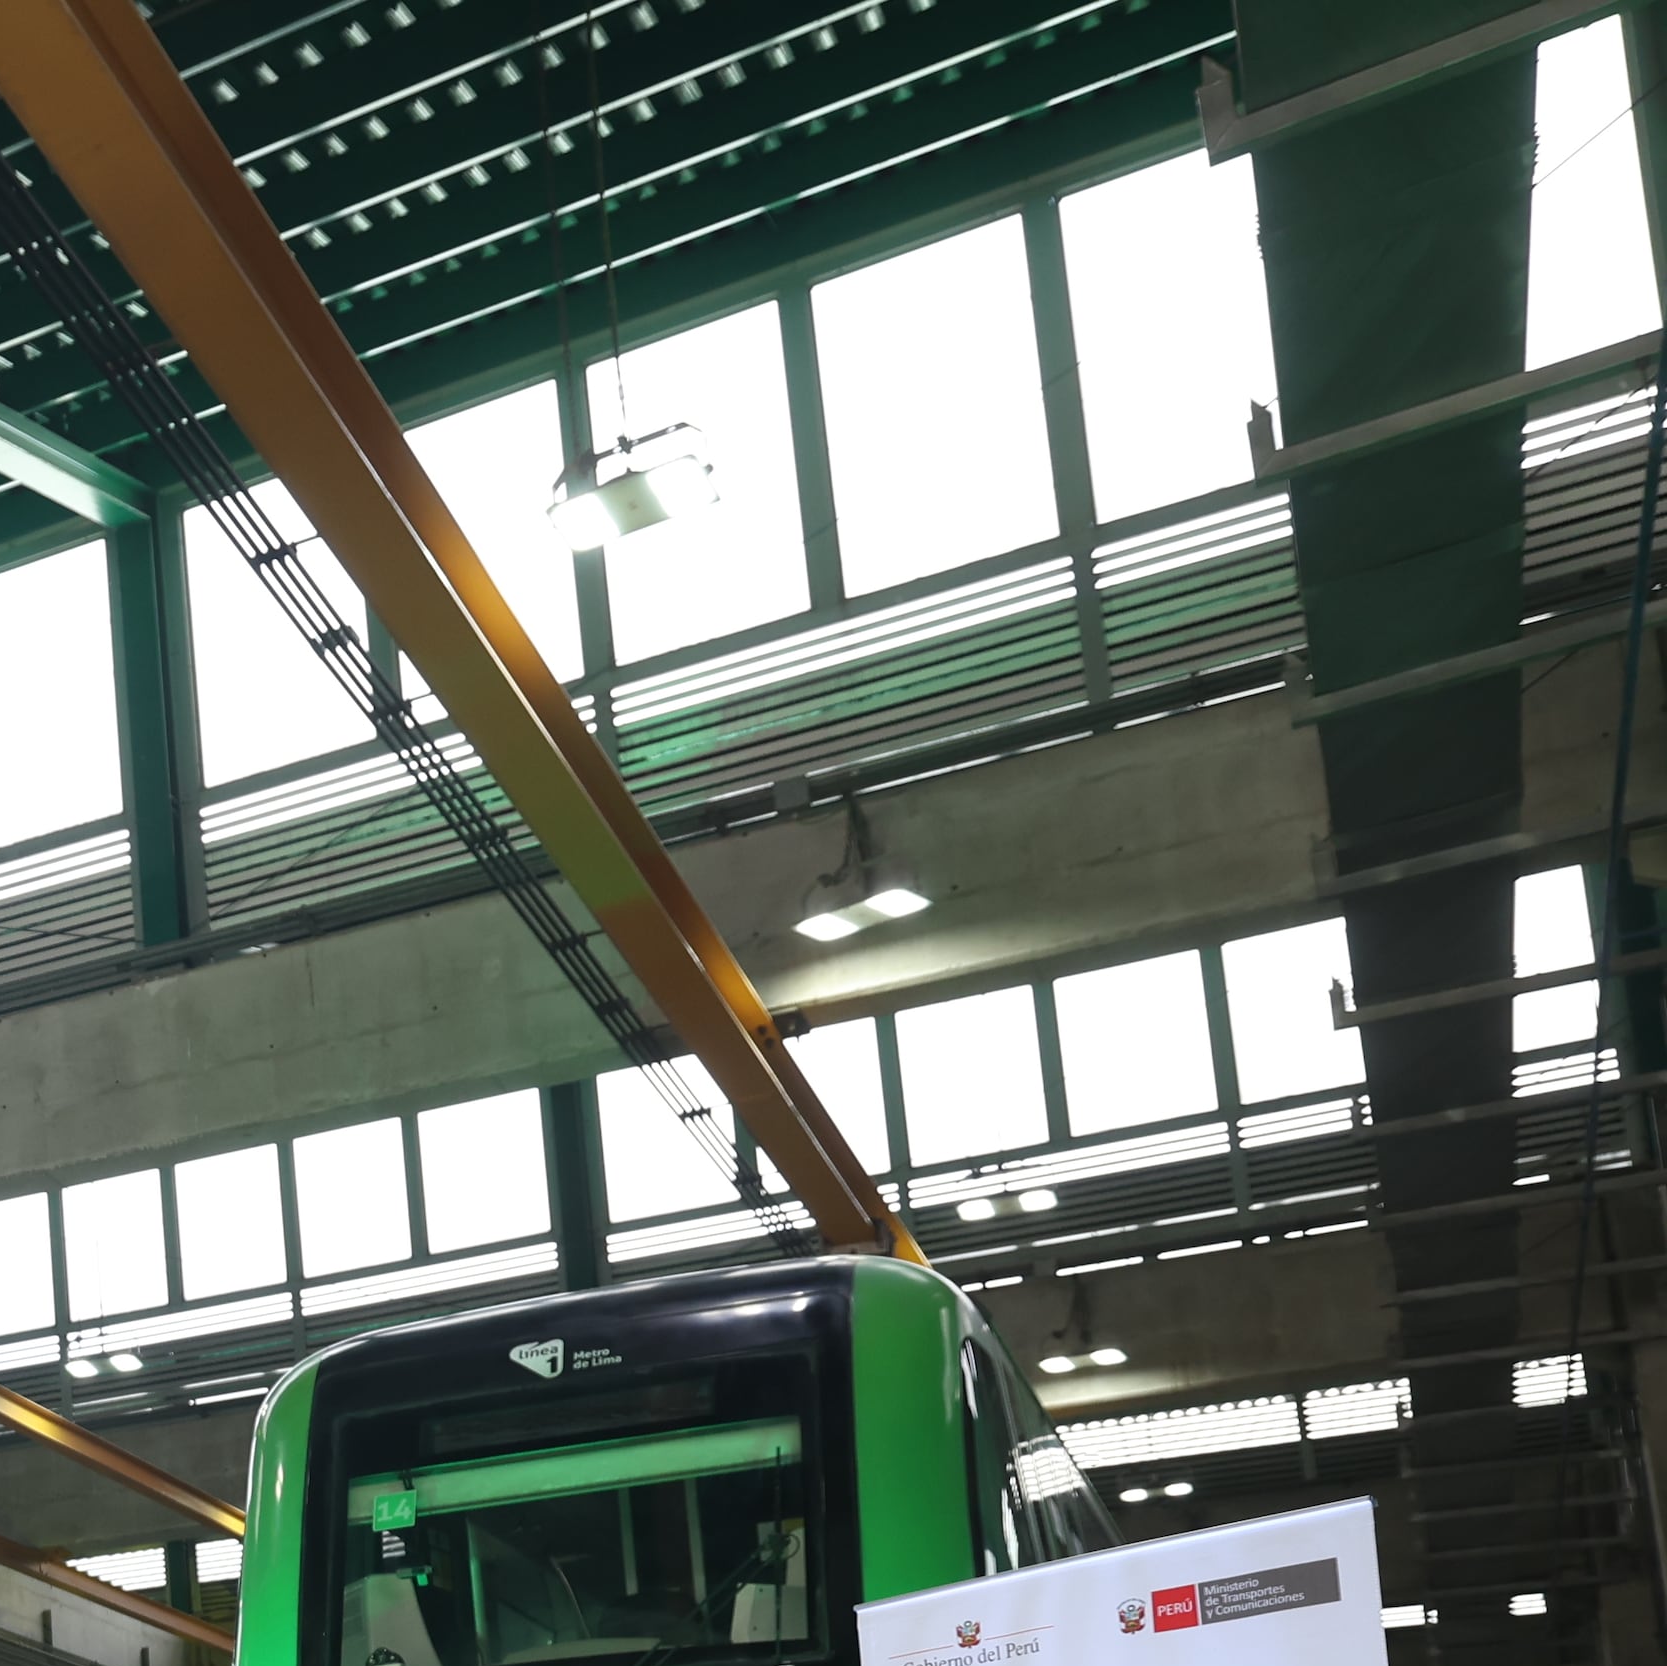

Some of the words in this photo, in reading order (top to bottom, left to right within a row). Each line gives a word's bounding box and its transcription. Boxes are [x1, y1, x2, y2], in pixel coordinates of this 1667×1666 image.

[572, 1348, 611, 1361] Metro
[572, 1359, 590, 1370] de
[592, 1354, 623, 1367] Lima
[547, 1356, 559, 1374] 1
[377, 1498, 413, 1522] 14
[1203, 1577, 1260, 1596] Ministerio
[1205, 1595, 1220, 1607] de
[1221, 1584, 1286, 1606] Transportes
[1156, 1598, 1194, 1617] PERÚ
[1206, 1609, 1213, 1619] y
[1215, 1591, 1306, 1616] Comunicaciones
[977, 1646, 1001, 1665] del
[1005, 1637, 1041, 1659] Perú
